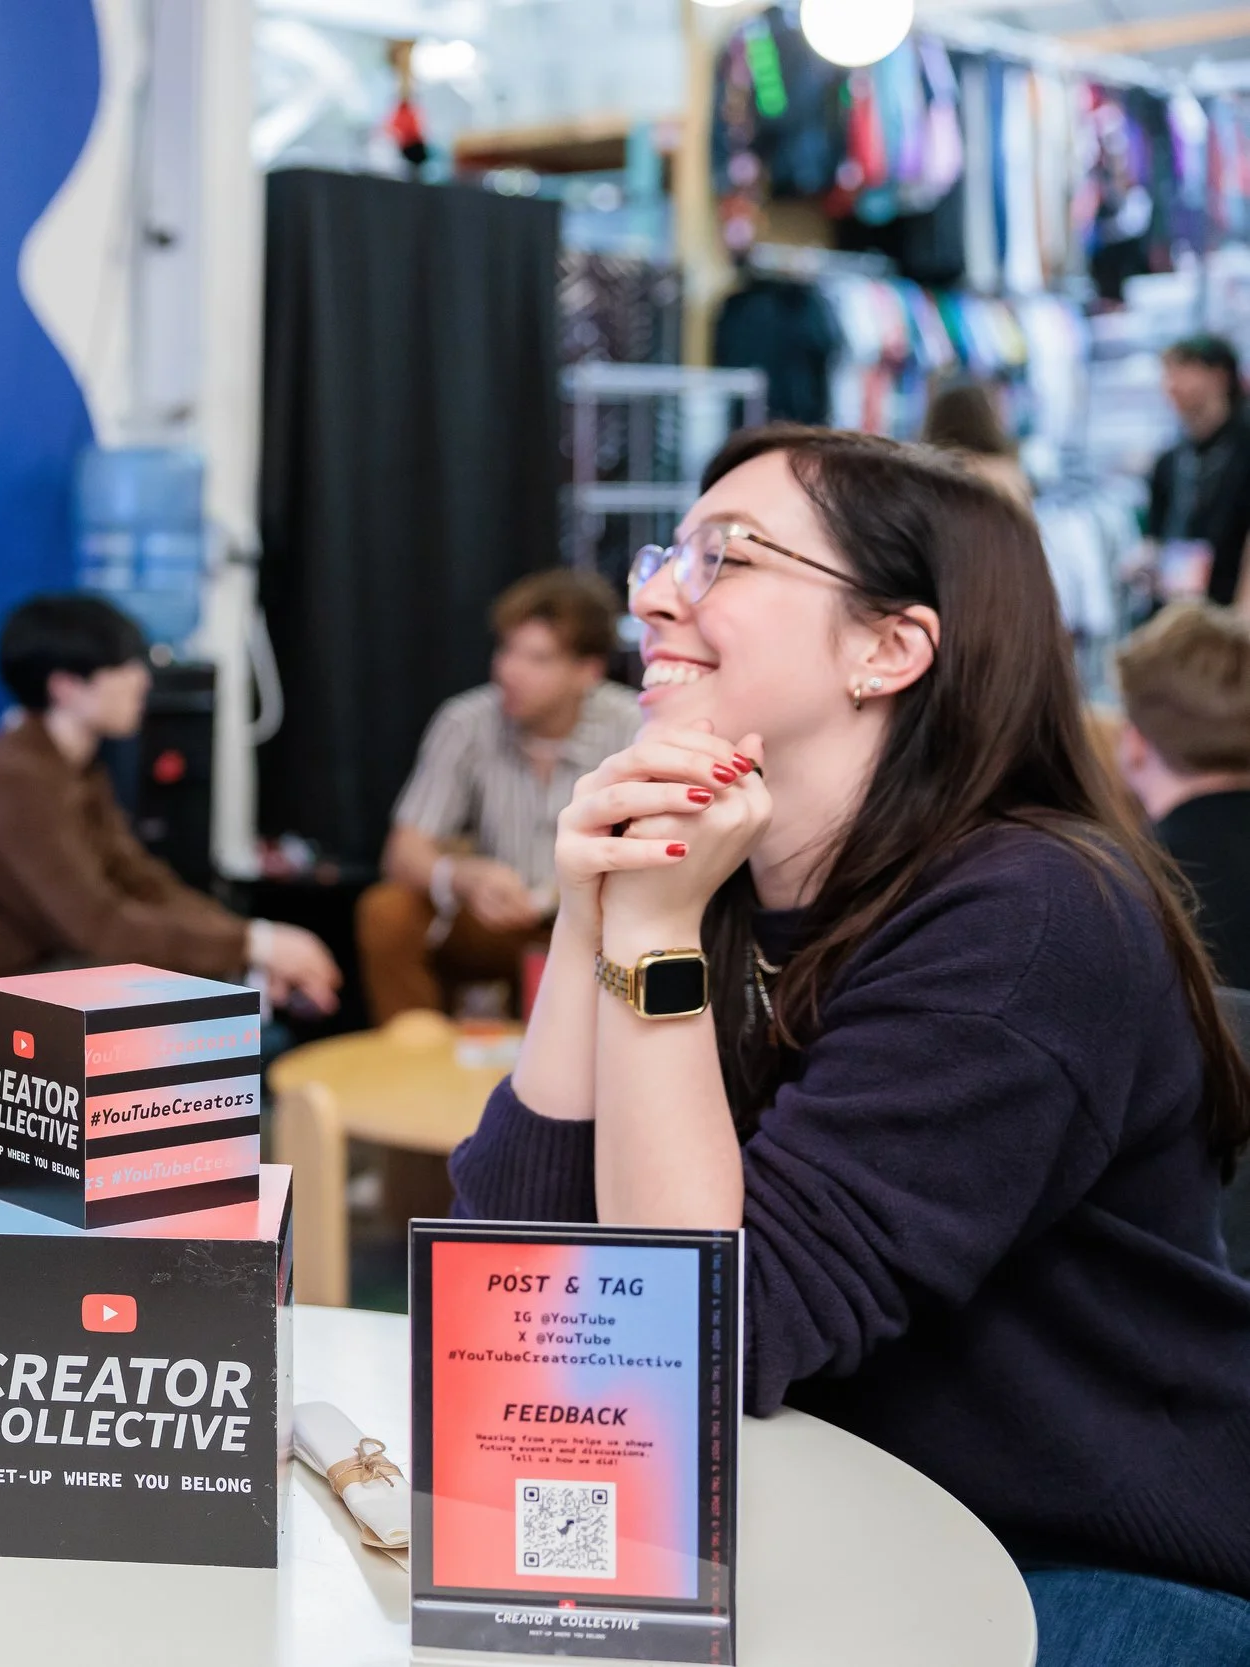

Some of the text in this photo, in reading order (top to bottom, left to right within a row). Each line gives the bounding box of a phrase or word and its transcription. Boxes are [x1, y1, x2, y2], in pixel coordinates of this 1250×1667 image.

[90, 1092, 254, 1127] #YouTubeCreators
[7, 1147, 30, 1164] WHERE
[34, 1155, 48, 1170] YOU
[51, 1161, 80, 1180] BELONG
[487, 1273, 644, 1296] POST & TAG
[513, 1311, 616, 1326] IG @YouTube
[518, 1331, 611, 1345] X @YouTube
[448, 1350, 682, 1368] #YouTubeCreatorCollective
[503, 1403, 628, 1426] FEEDBACK
[479, 1443, 513, 1452] future
[522, 1435, 544, 1443] from
[550, 1437, 567, 1445] you
[572, 1437, 601, 1446] helps
[625, 1439, 654, 1448] shape
[510, 1454, 532, 1462] Tell
[556, 1456, 573, 1464] how
[596, 1458, 618, 1466] did!
[64, 1471, 122, 1488] WHERE
[134, 1474, 169, 1490] YOU
[181, 1476, 252, 1493] BELONG
[494, 1611, 640, 1631] CREATOR COLLECTIVE
